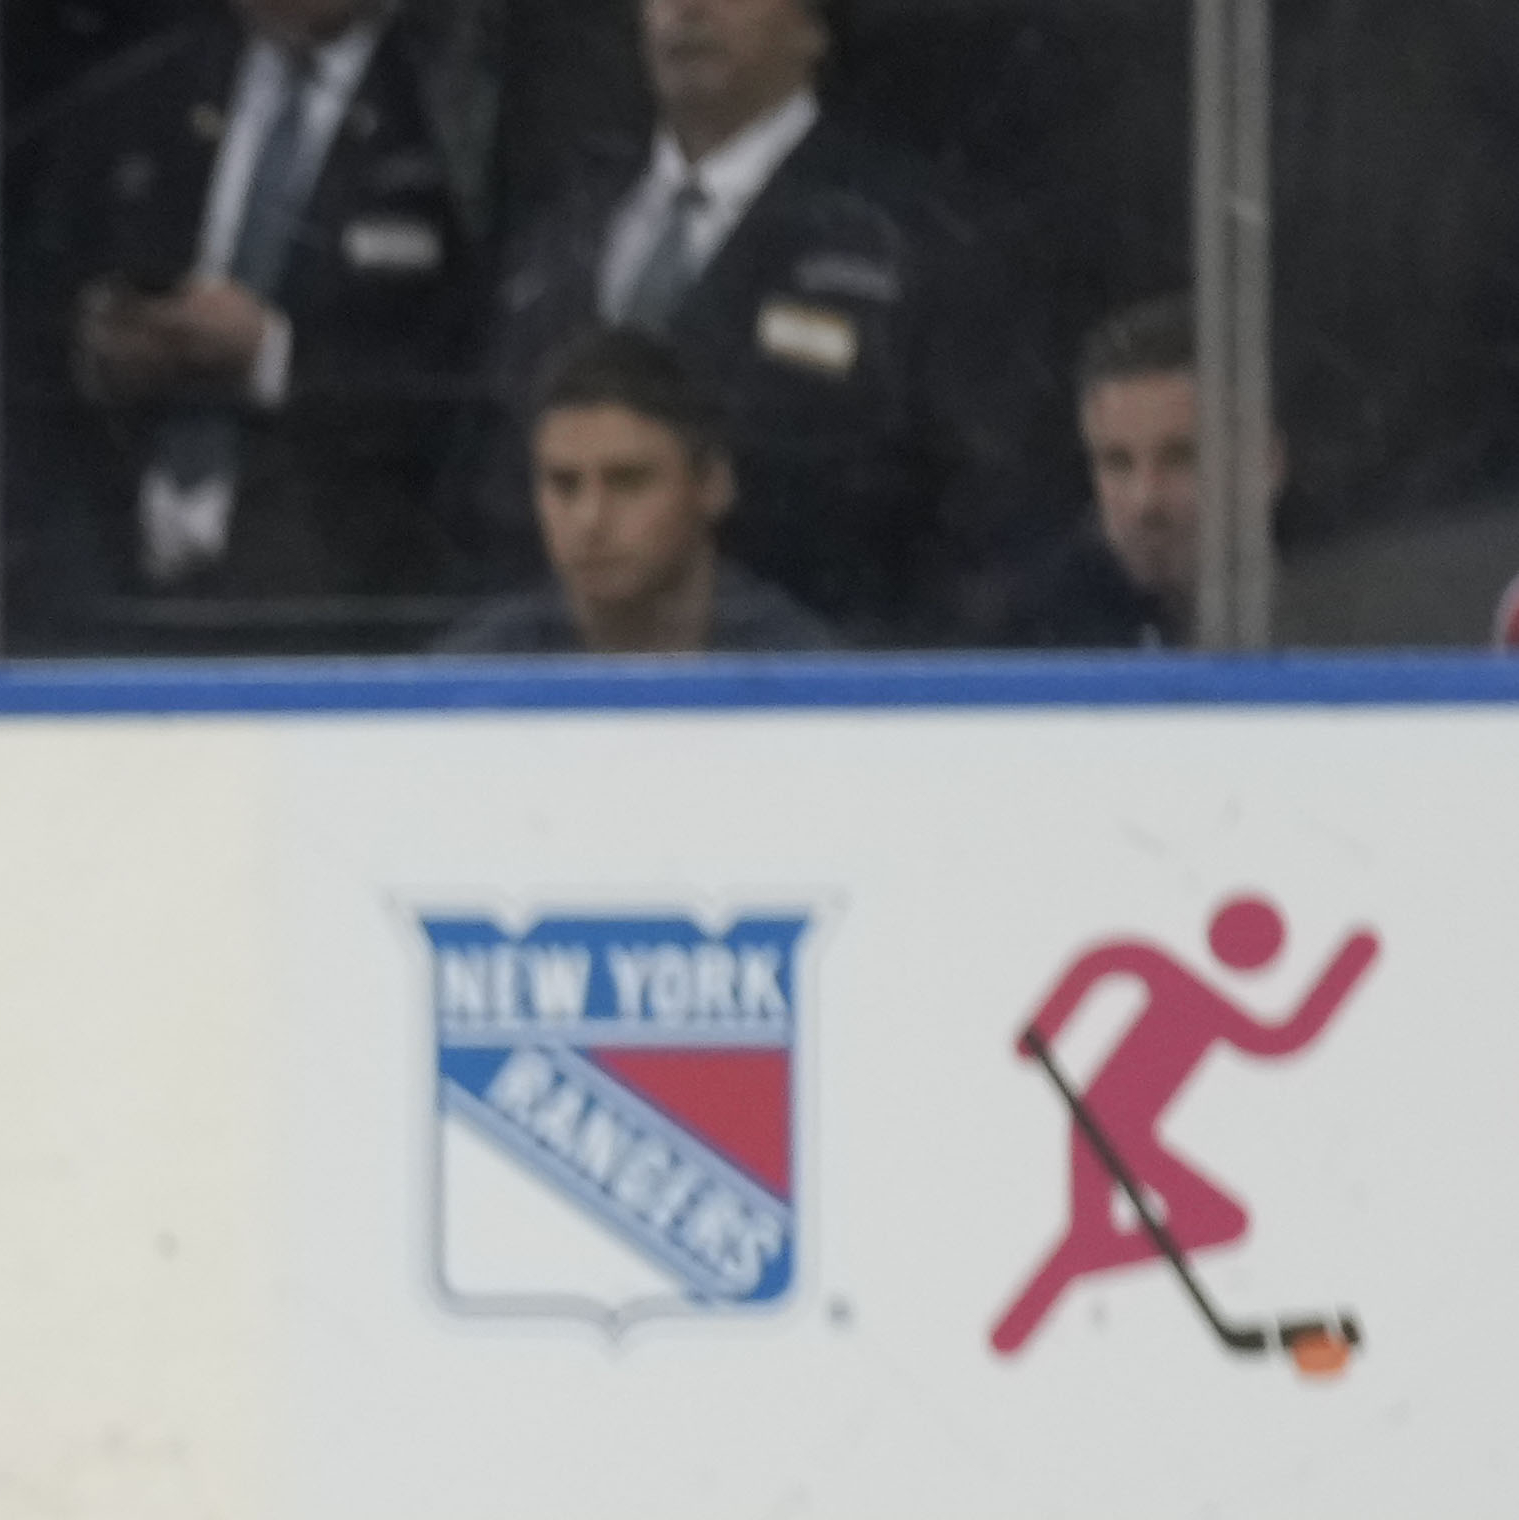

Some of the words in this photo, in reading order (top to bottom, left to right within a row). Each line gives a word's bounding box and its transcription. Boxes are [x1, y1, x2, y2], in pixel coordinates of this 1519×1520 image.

[439, 943, 594, 1026] NEW
[607, 943, 790, 1026] YORK
[486, 1047, 783, 1290] RANGERS
